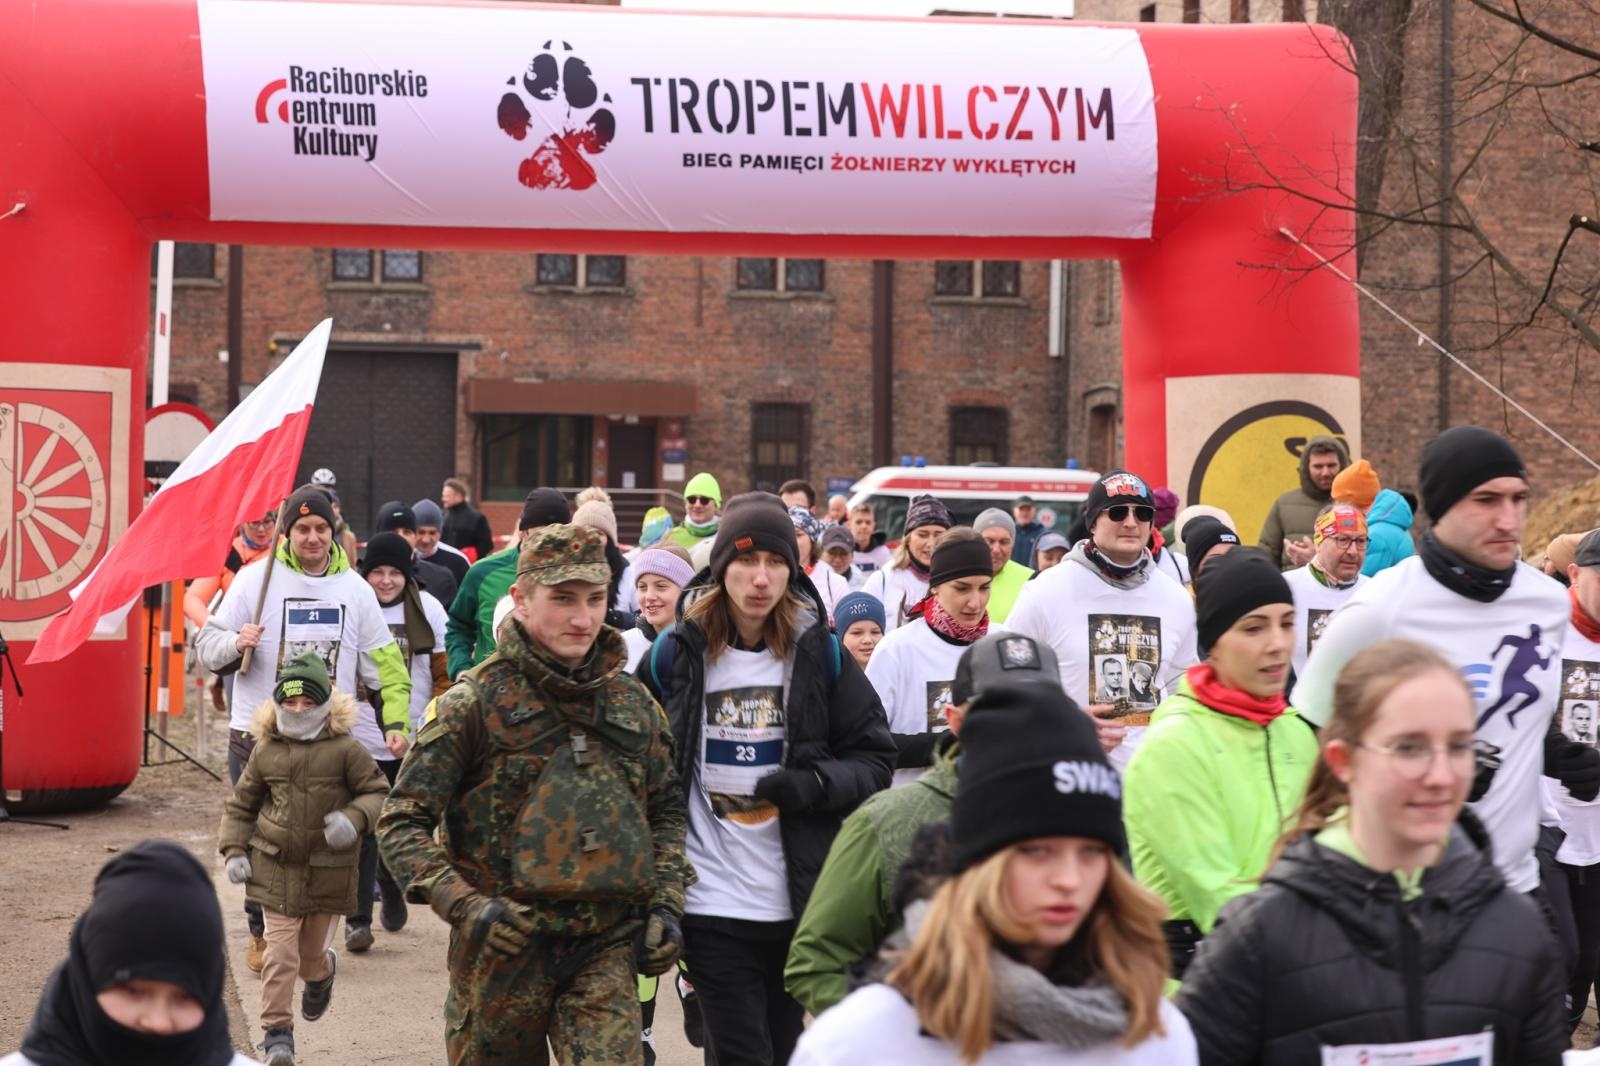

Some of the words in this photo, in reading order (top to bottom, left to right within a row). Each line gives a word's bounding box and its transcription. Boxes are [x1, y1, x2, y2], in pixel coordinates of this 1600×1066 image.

[289, 65, 428, 98] Raciborskie
[293, 126, 378, 162] Kultury
[682, 152, 733, 169] BIEG
[739, 154, 824, 174] PAMIĘCI
[831, 151, 947, 173] ŻOŁNIERZY
[953, 155, 1077, 177] WYKLĘTYCH
[308, 610, 320, 621] 21
[735, 744, 757, 762] 23
